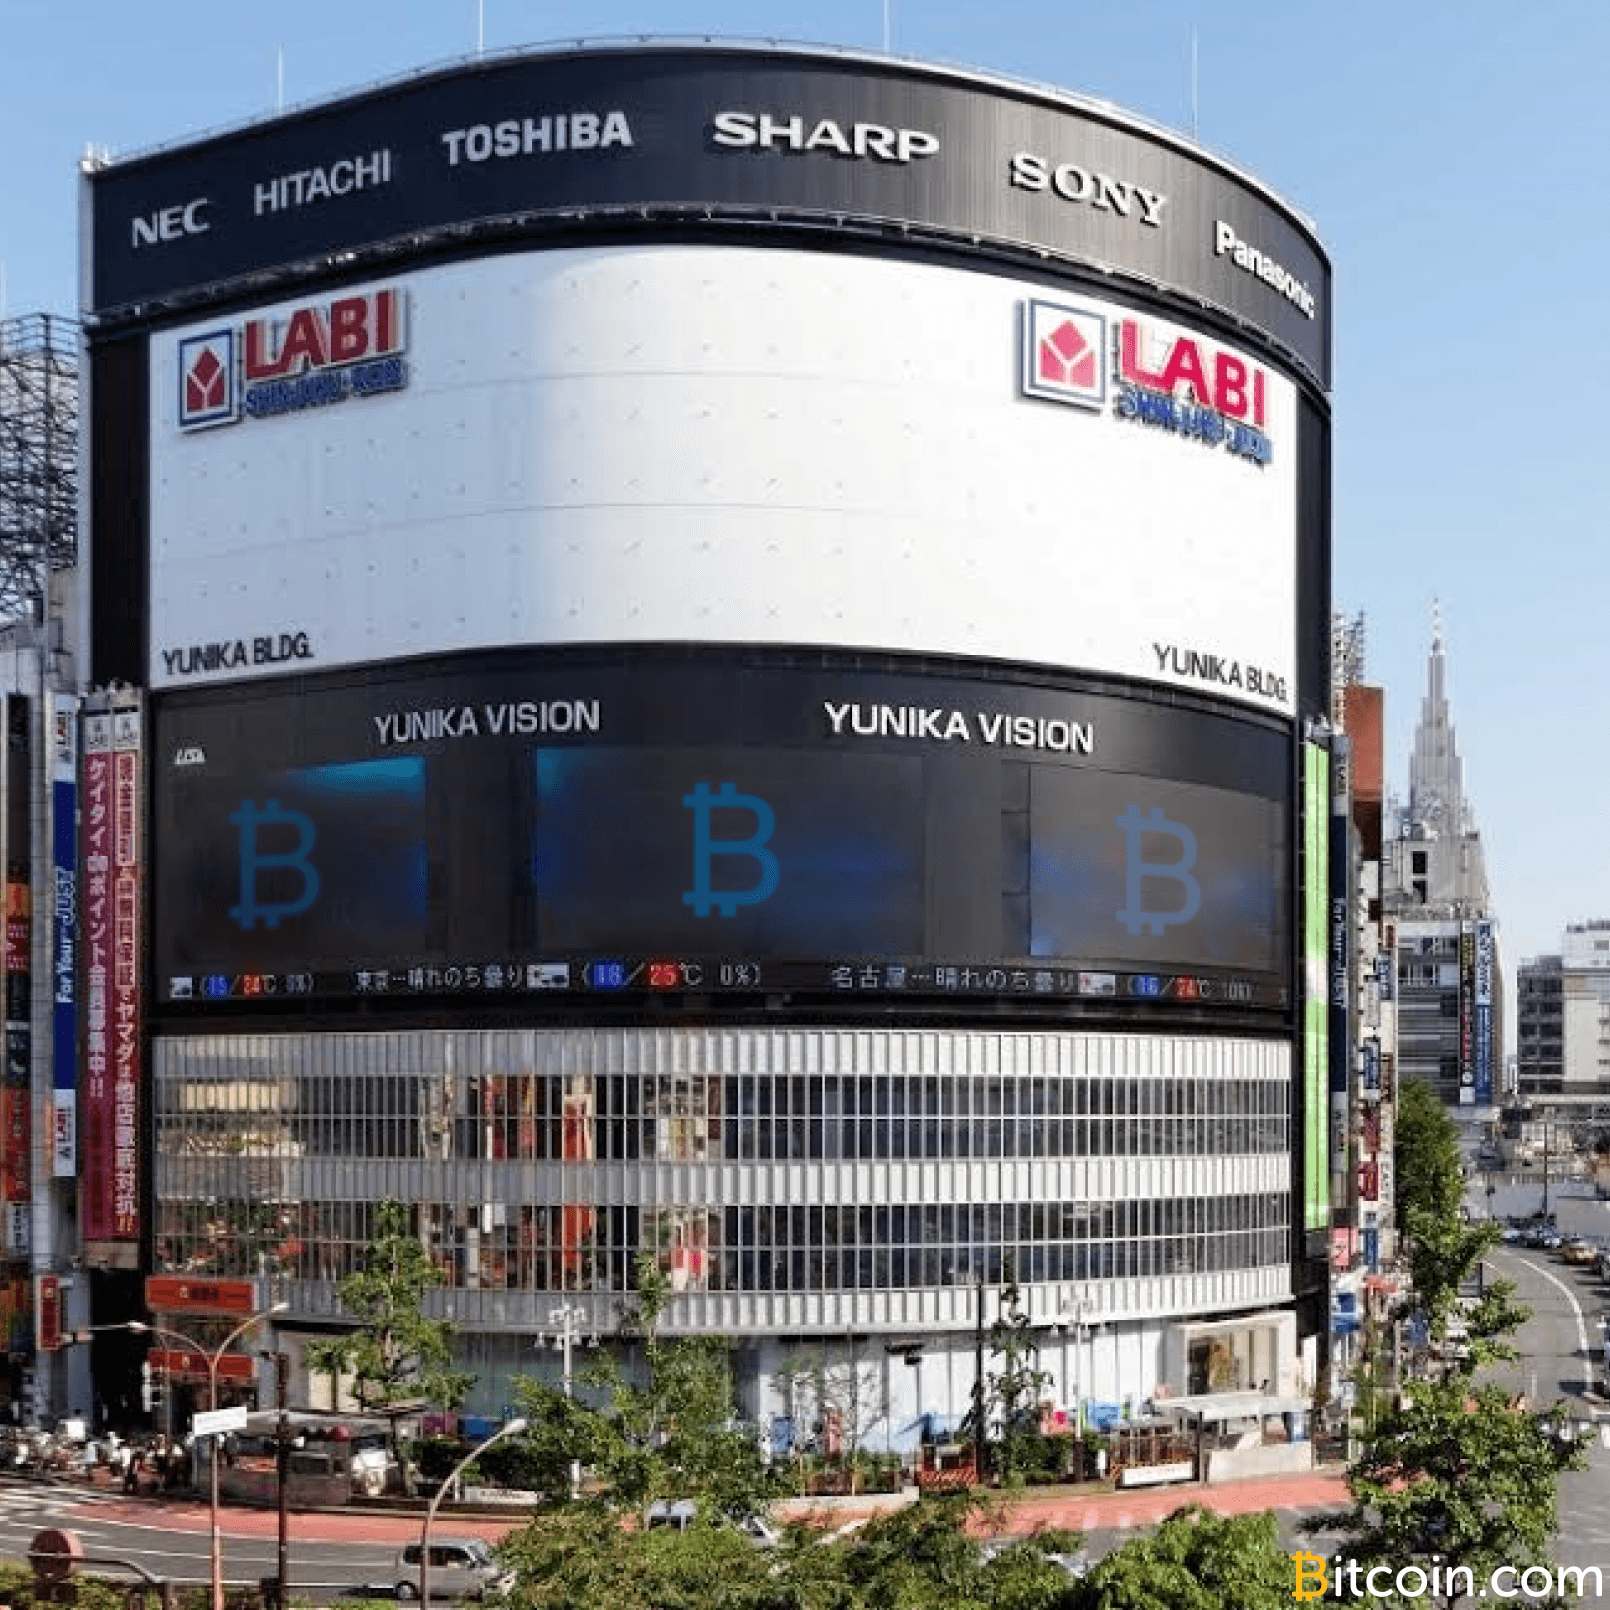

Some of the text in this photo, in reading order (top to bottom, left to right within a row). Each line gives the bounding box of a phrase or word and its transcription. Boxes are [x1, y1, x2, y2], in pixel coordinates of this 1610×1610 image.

[442, 111, 634, 165] TOSHIBA
[713, 111, 940, 162] SHARP
[254, 149, 392, 215] HITACHI
[1010, 152, 1169, 228] SONY
[131, 198, 210, 248] NEC
[1214, 220, 1316, 319] Panasonic
[245, 289, 396, 380] LABI
[1121, 318, 1266, 428] LABI
[162, 639, 248, 676] YUNIKA
[1152, 642, 1243, 688] YUNIKA
[373, 699, 601, 745] YUNIKA VISION
[824, 700, 1094, 754] YUNIKA VISION
